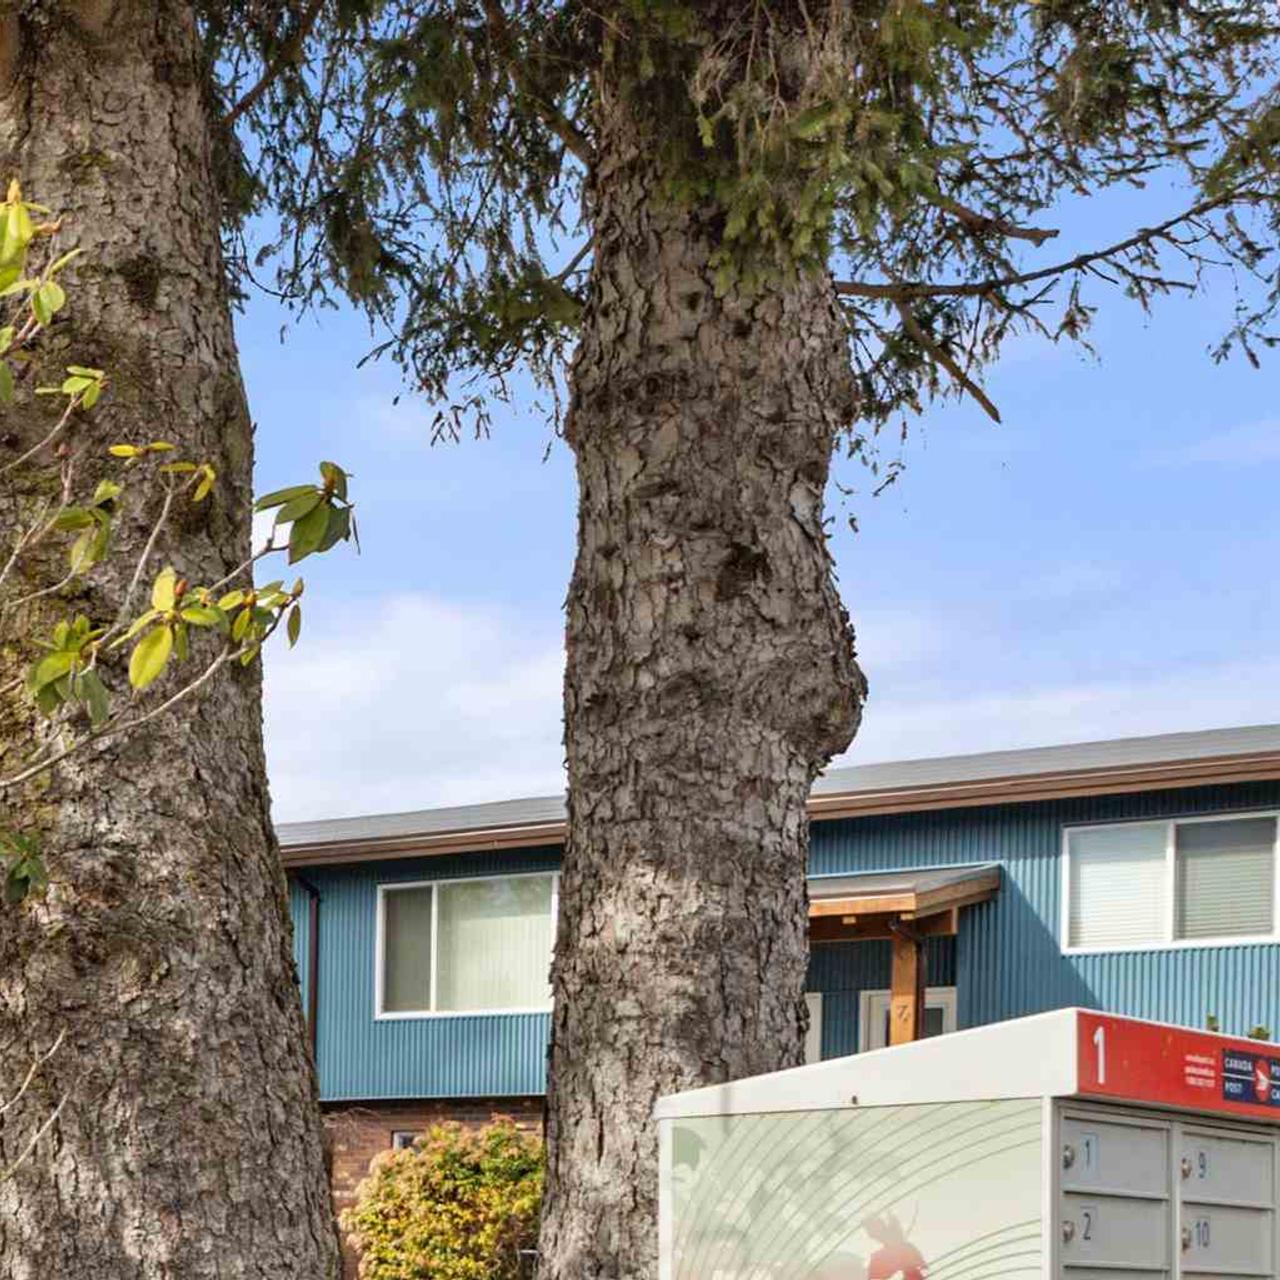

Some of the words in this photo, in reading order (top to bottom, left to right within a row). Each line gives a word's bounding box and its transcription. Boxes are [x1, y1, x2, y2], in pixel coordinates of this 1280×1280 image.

[1093, 1025, 1105, 1085] 1
[1225, 1057, 1253, 1072] CANADA
[1225, 1081, 1242, 1093] POST
[1084, 1138, 1091, 1169] 1
[1198, 1152, 1207, 1179] 9
[1083, 1212, 1091, 1240] 2
[1196, 1220, 1210, 1248] 10
